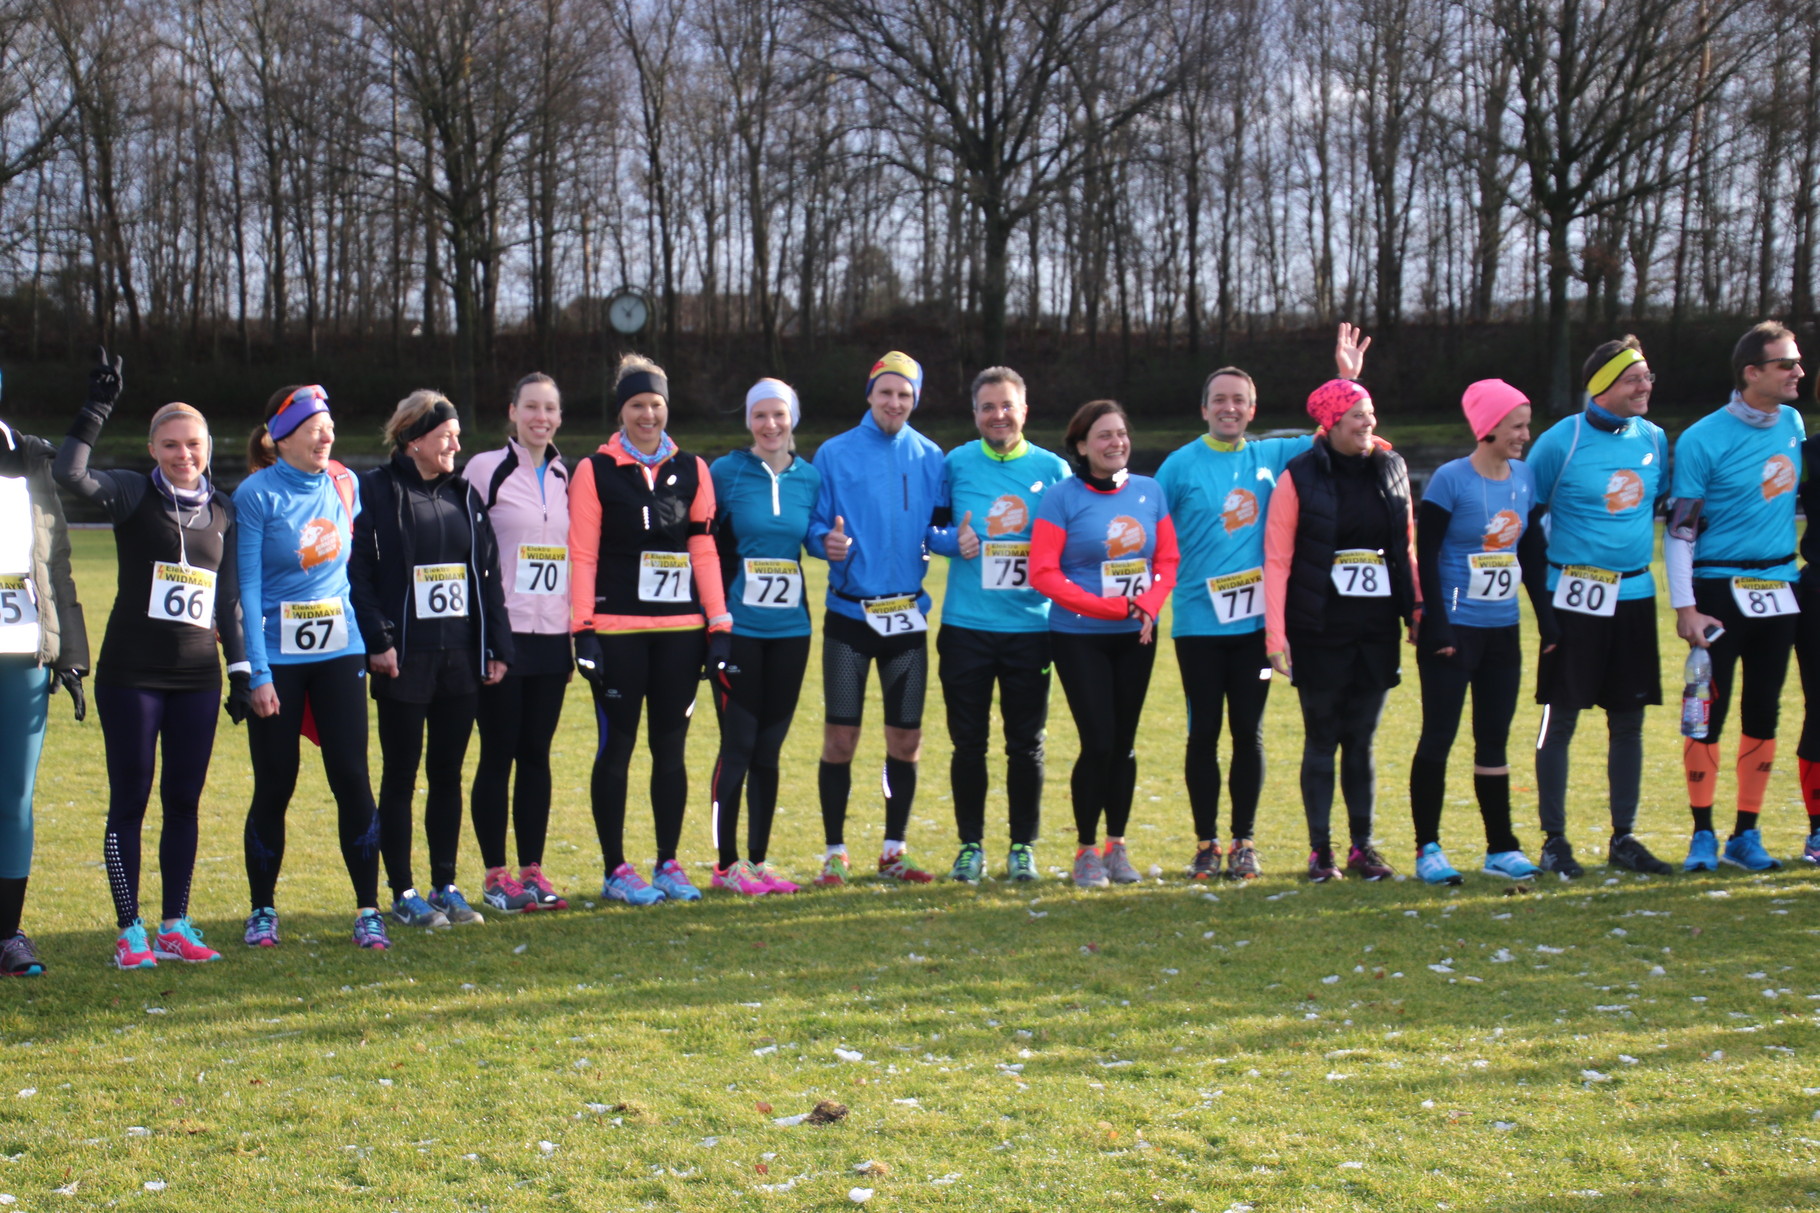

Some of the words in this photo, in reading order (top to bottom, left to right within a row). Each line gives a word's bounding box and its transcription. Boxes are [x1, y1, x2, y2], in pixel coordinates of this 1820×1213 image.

[527, 552, 566, 562] WIDMAYR
[165, 572, 213, 589] WIDMAYR
[424, 572, 466, 582] WIDMAYR
[529, 562, 558, 591] 70
[653, 570, 681, 598] 71
[754, 567, 800, 575] WIDMAYR
[994, 558, 1027, 586] 75
[1217, 575, 1263, 592] WIDMAYR
[1343, 565, 1378, 593] 78
[1482, 568, 1512, 597] 79
[1570, 570, 1618, 585] WIDMAYR
[428, 582, 464, 613] 68
[757, 576, 790, 603] 72
[1115, 575, 1145, 597] 76
[1566, 579, 1606, 611] 80
[0, 591, 22, 624] 5
[164, 584, 204, 620] 66
[293, 608, 343, 620] WIDMAYR
[871, 601, 916, 614] WIDMAYR
[1221, 586, 1255, 619] 77
[1748, 590, 1782, 614] 81
[295, 618, 334, 650] 67
[876, 613, 914, 633] 73
